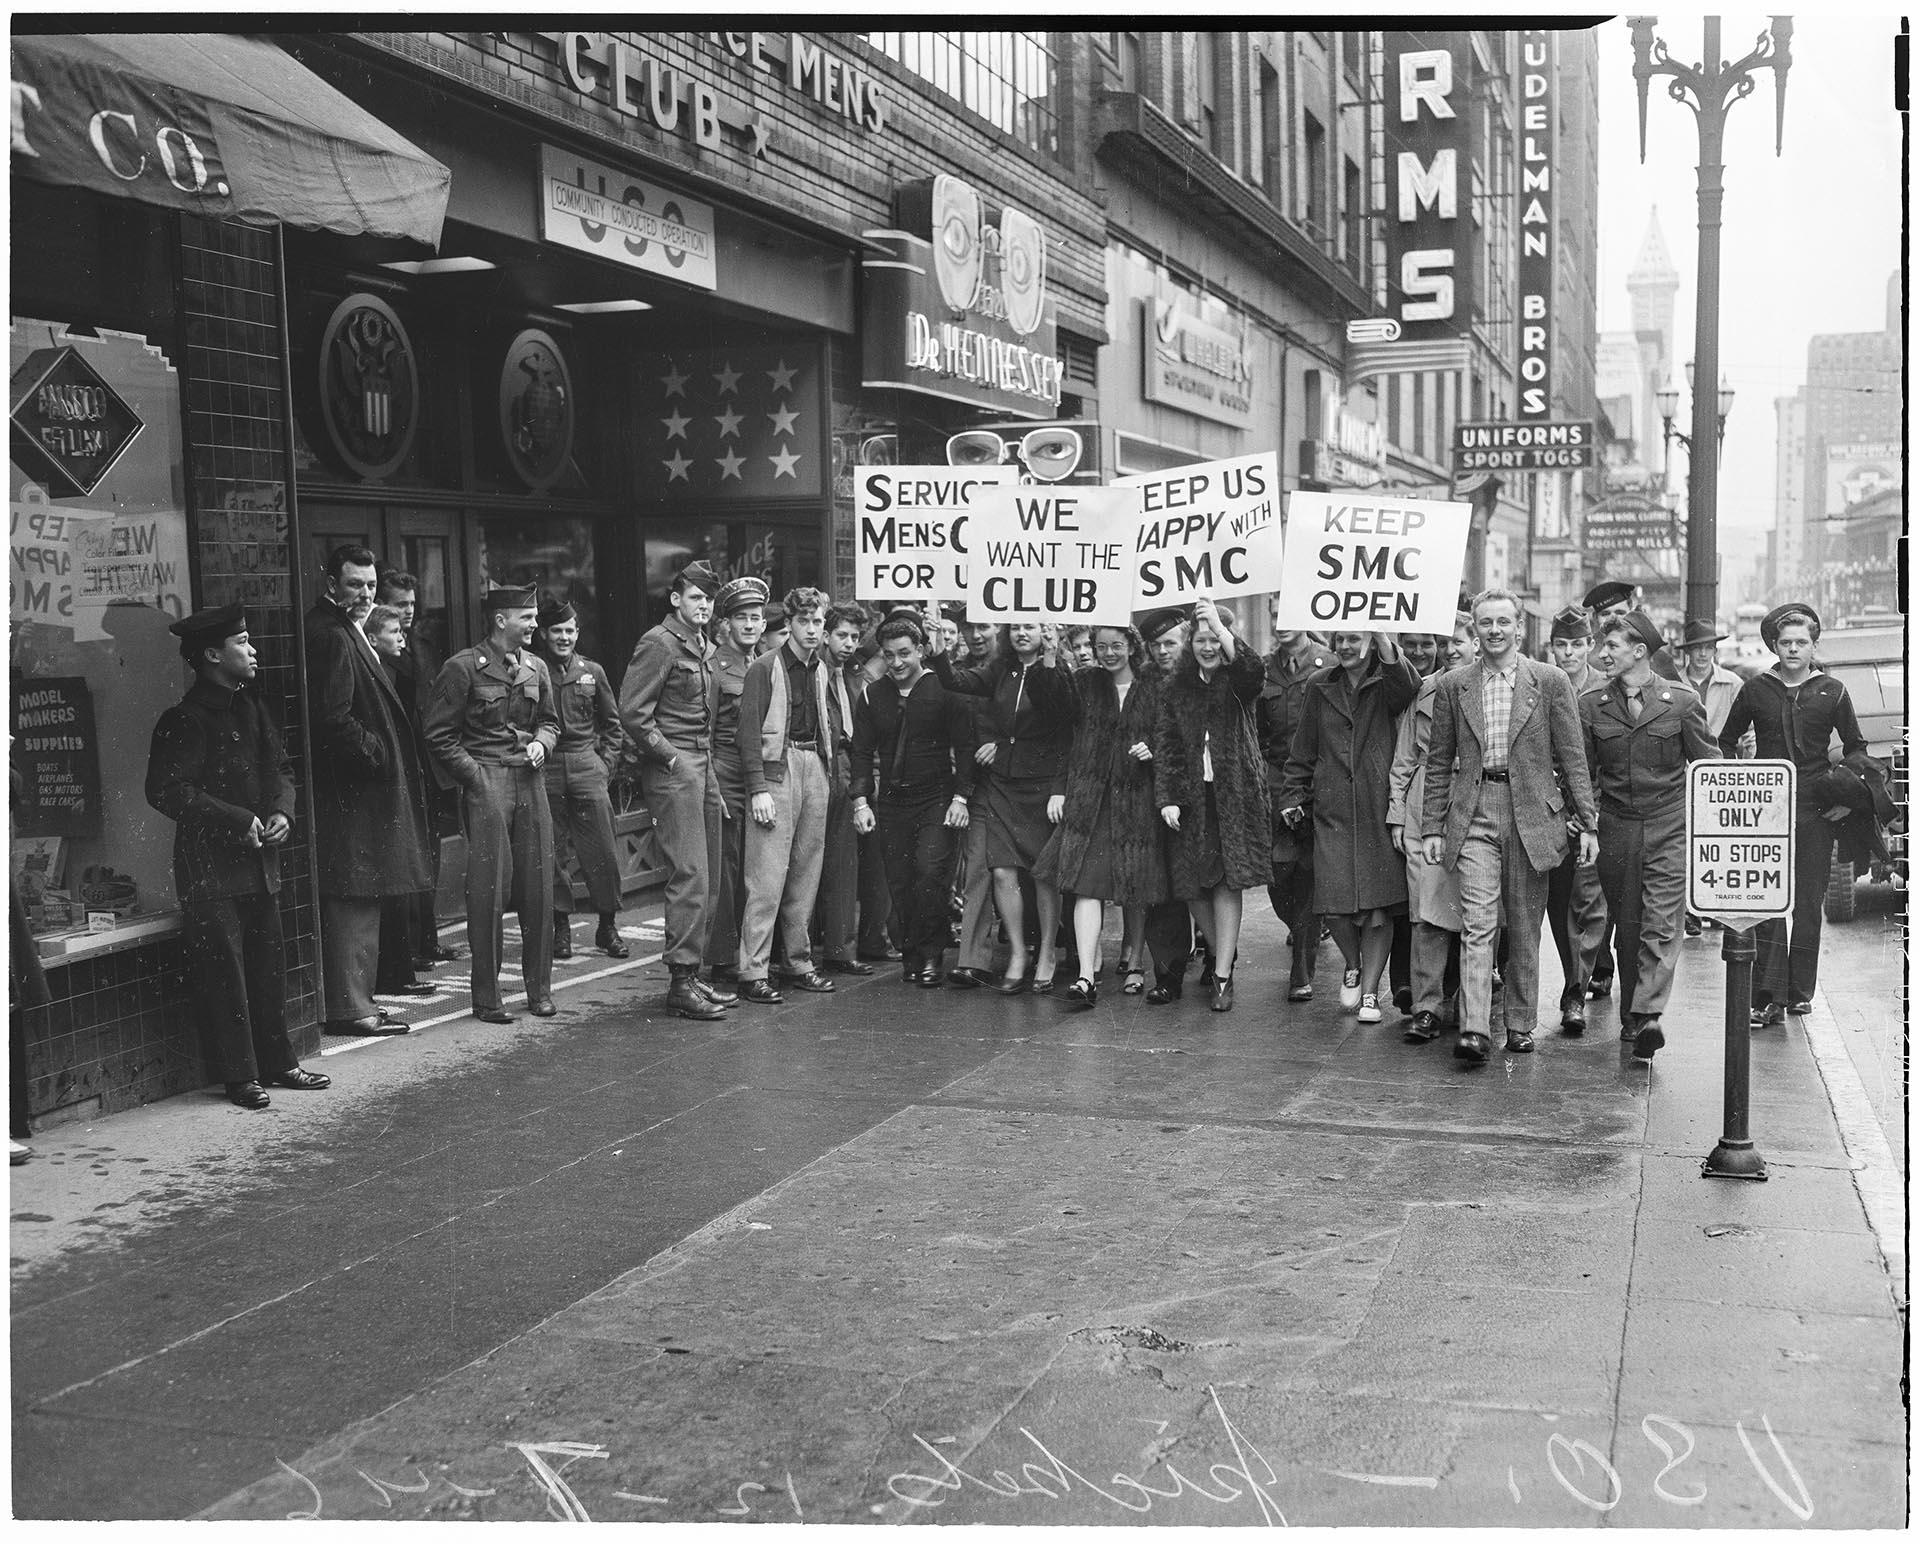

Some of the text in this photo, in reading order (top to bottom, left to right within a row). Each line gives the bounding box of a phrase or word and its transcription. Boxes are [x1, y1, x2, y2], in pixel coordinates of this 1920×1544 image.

[560, 32, 721, 152] CLUB
[788, 32, 883, 134] MENS
[89, 109, 229, 193] CO.
[556, 185, 706, 252] COMMUNITY CONDUCTED OPERATION
[1520, 30, 1550, 414] UDELMAN BROS
[942, 323, 1064, 407] HENNESSEY
[1462, 425, 1583, 448] UNIFORMS
[1463, 449, 1583, 468] SPORT TOGS
[864, 474, 999, 512] SERVIC
[1136, 465, 1266, 514] EEP US
[1016, 498, 1079, 531] WE
[1230, 500, 1273, 538] WITH
[1323, 504, 1426, 536] KEEP
[986, 541, 1123, 570] WANT THE
[1636, 536, 1672, 549] MILLS
[873, 564, 935, 589] FOR
[1139, 547, 1249, 597] SMC
[1317, 544, 1422, 581] SMC
[982, 576, 1098, 614] CLUB
[1310, 590, 1420, 622] OPEN
[19, 690, 66, 710] MODEL
[18, 706, 76, 730] MAKERS
[37, 762, 59, 773] BOATS
[38, 774, 73, 784] AIRPLANES
[1701, 772, 1784, 786] PASSENGER
[39, 785, 84, 795] GAS MOTORS
[40, 796, 76, 806] RACE CARS
[1709, 790, 1773, 803] LOADING
[1719, 808, 1763, 828] ONLY
[1700, 844, 1781, 863] NO STOPS
